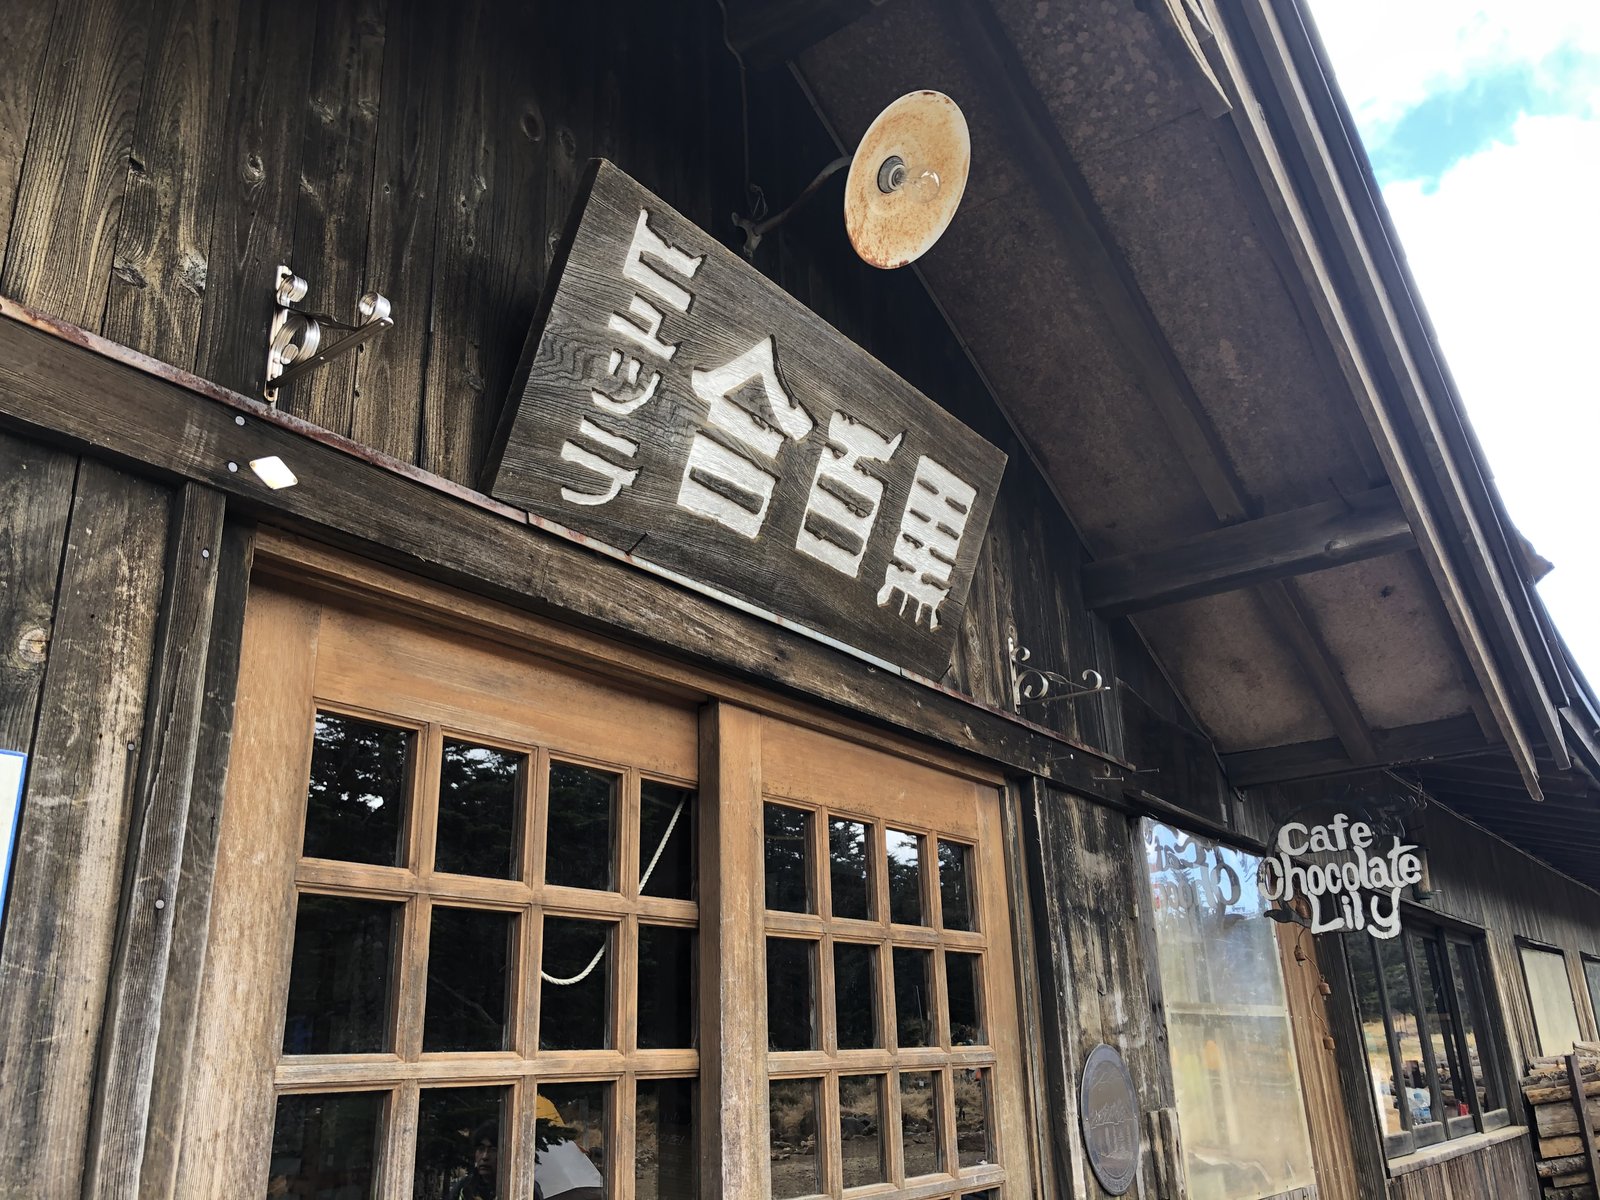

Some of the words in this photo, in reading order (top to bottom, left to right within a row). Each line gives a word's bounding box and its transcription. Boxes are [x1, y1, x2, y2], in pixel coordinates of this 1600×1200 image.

[560, 208, 707, 506] ヒュッテ
[677, 335, 978, 632] 黒百合
[1277, 813, 1373, 856] Cafe
[1257, 836, 1422, 901] Chocolate
[1307, 887, 1402, 940] Lily
